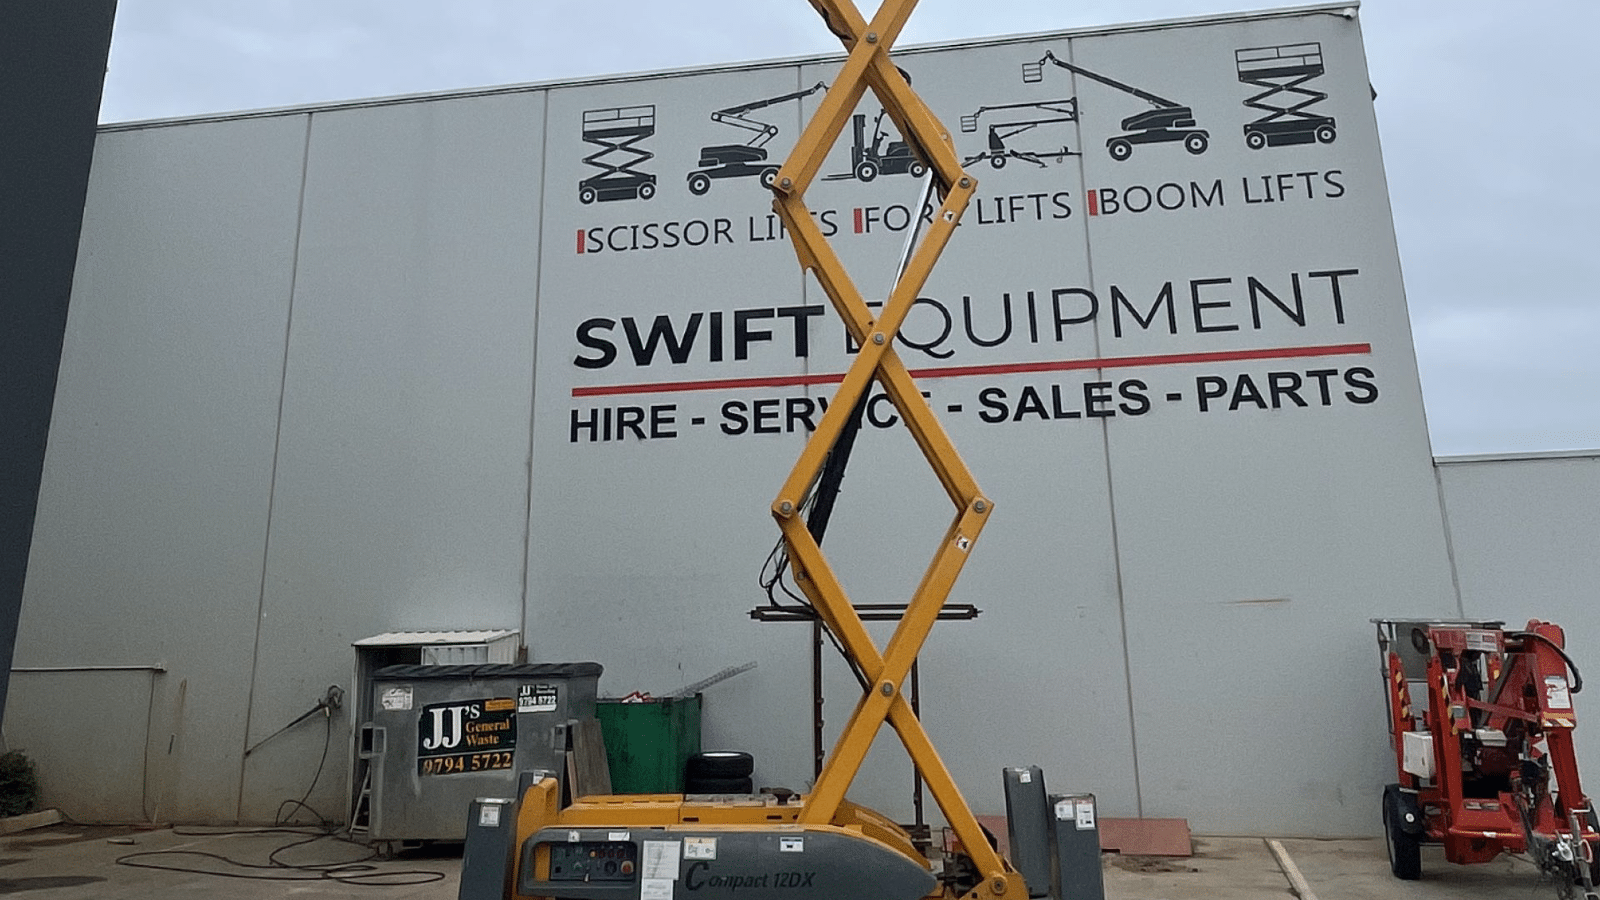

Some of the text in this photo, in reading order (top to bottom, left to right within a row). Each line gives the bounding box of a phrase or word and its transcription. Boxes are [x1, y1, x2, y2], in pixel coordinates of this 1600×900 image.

[864, 191, 1072, 233] FOR LIFTS
[1099, 170, 1345, 215] BOOM LIFTS
[587, 209, 838, 253] SCISSOR LIS
[573, 304, 825, 369] SWIFT
[570, 404, 677, 442] HIRE
[719, 391, 931, 435] SERC
[978, 379, 1151, 423] SALES
[1197, 367, 1379, 412] PARTS
[465, 718, 511, 733] General
[466, 734, 500, 747] Waste
[423, 752, 512, 774] 9794 5722
[685, 861, 768, 892] Compact
[774, 872, 816, 888] 12DX
